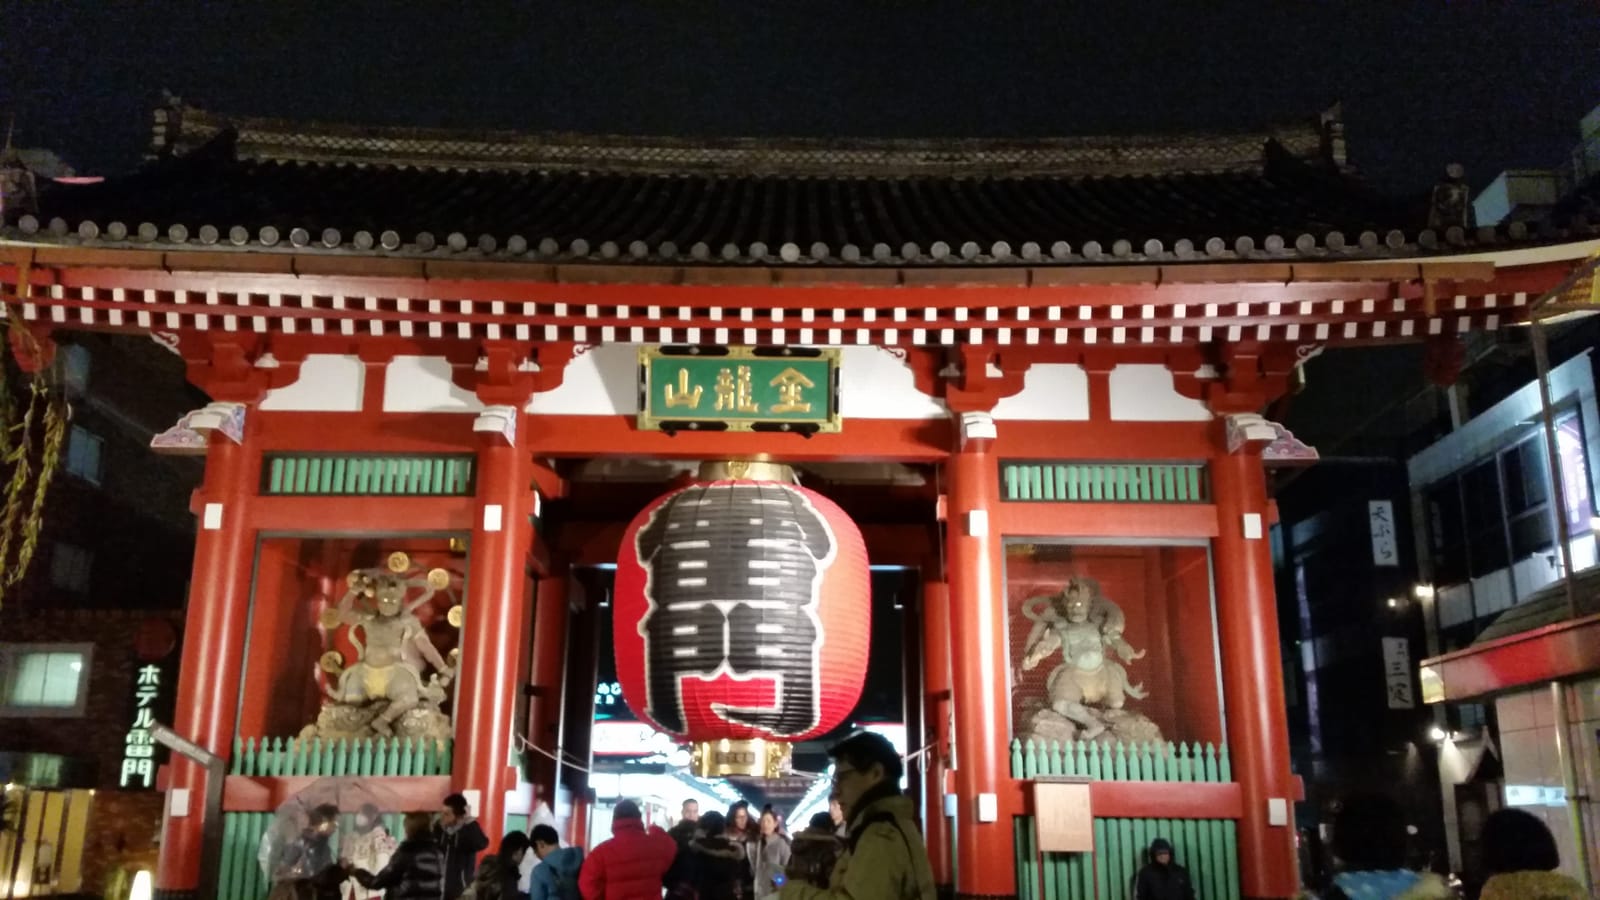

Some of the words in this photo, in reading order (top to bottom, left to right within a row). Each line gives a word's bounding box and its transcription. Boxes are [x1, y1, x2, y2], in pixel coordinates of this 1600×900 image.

[635, 483, 839, 738] 雷門
[120, 664, 161, 788] ホテル雷門
